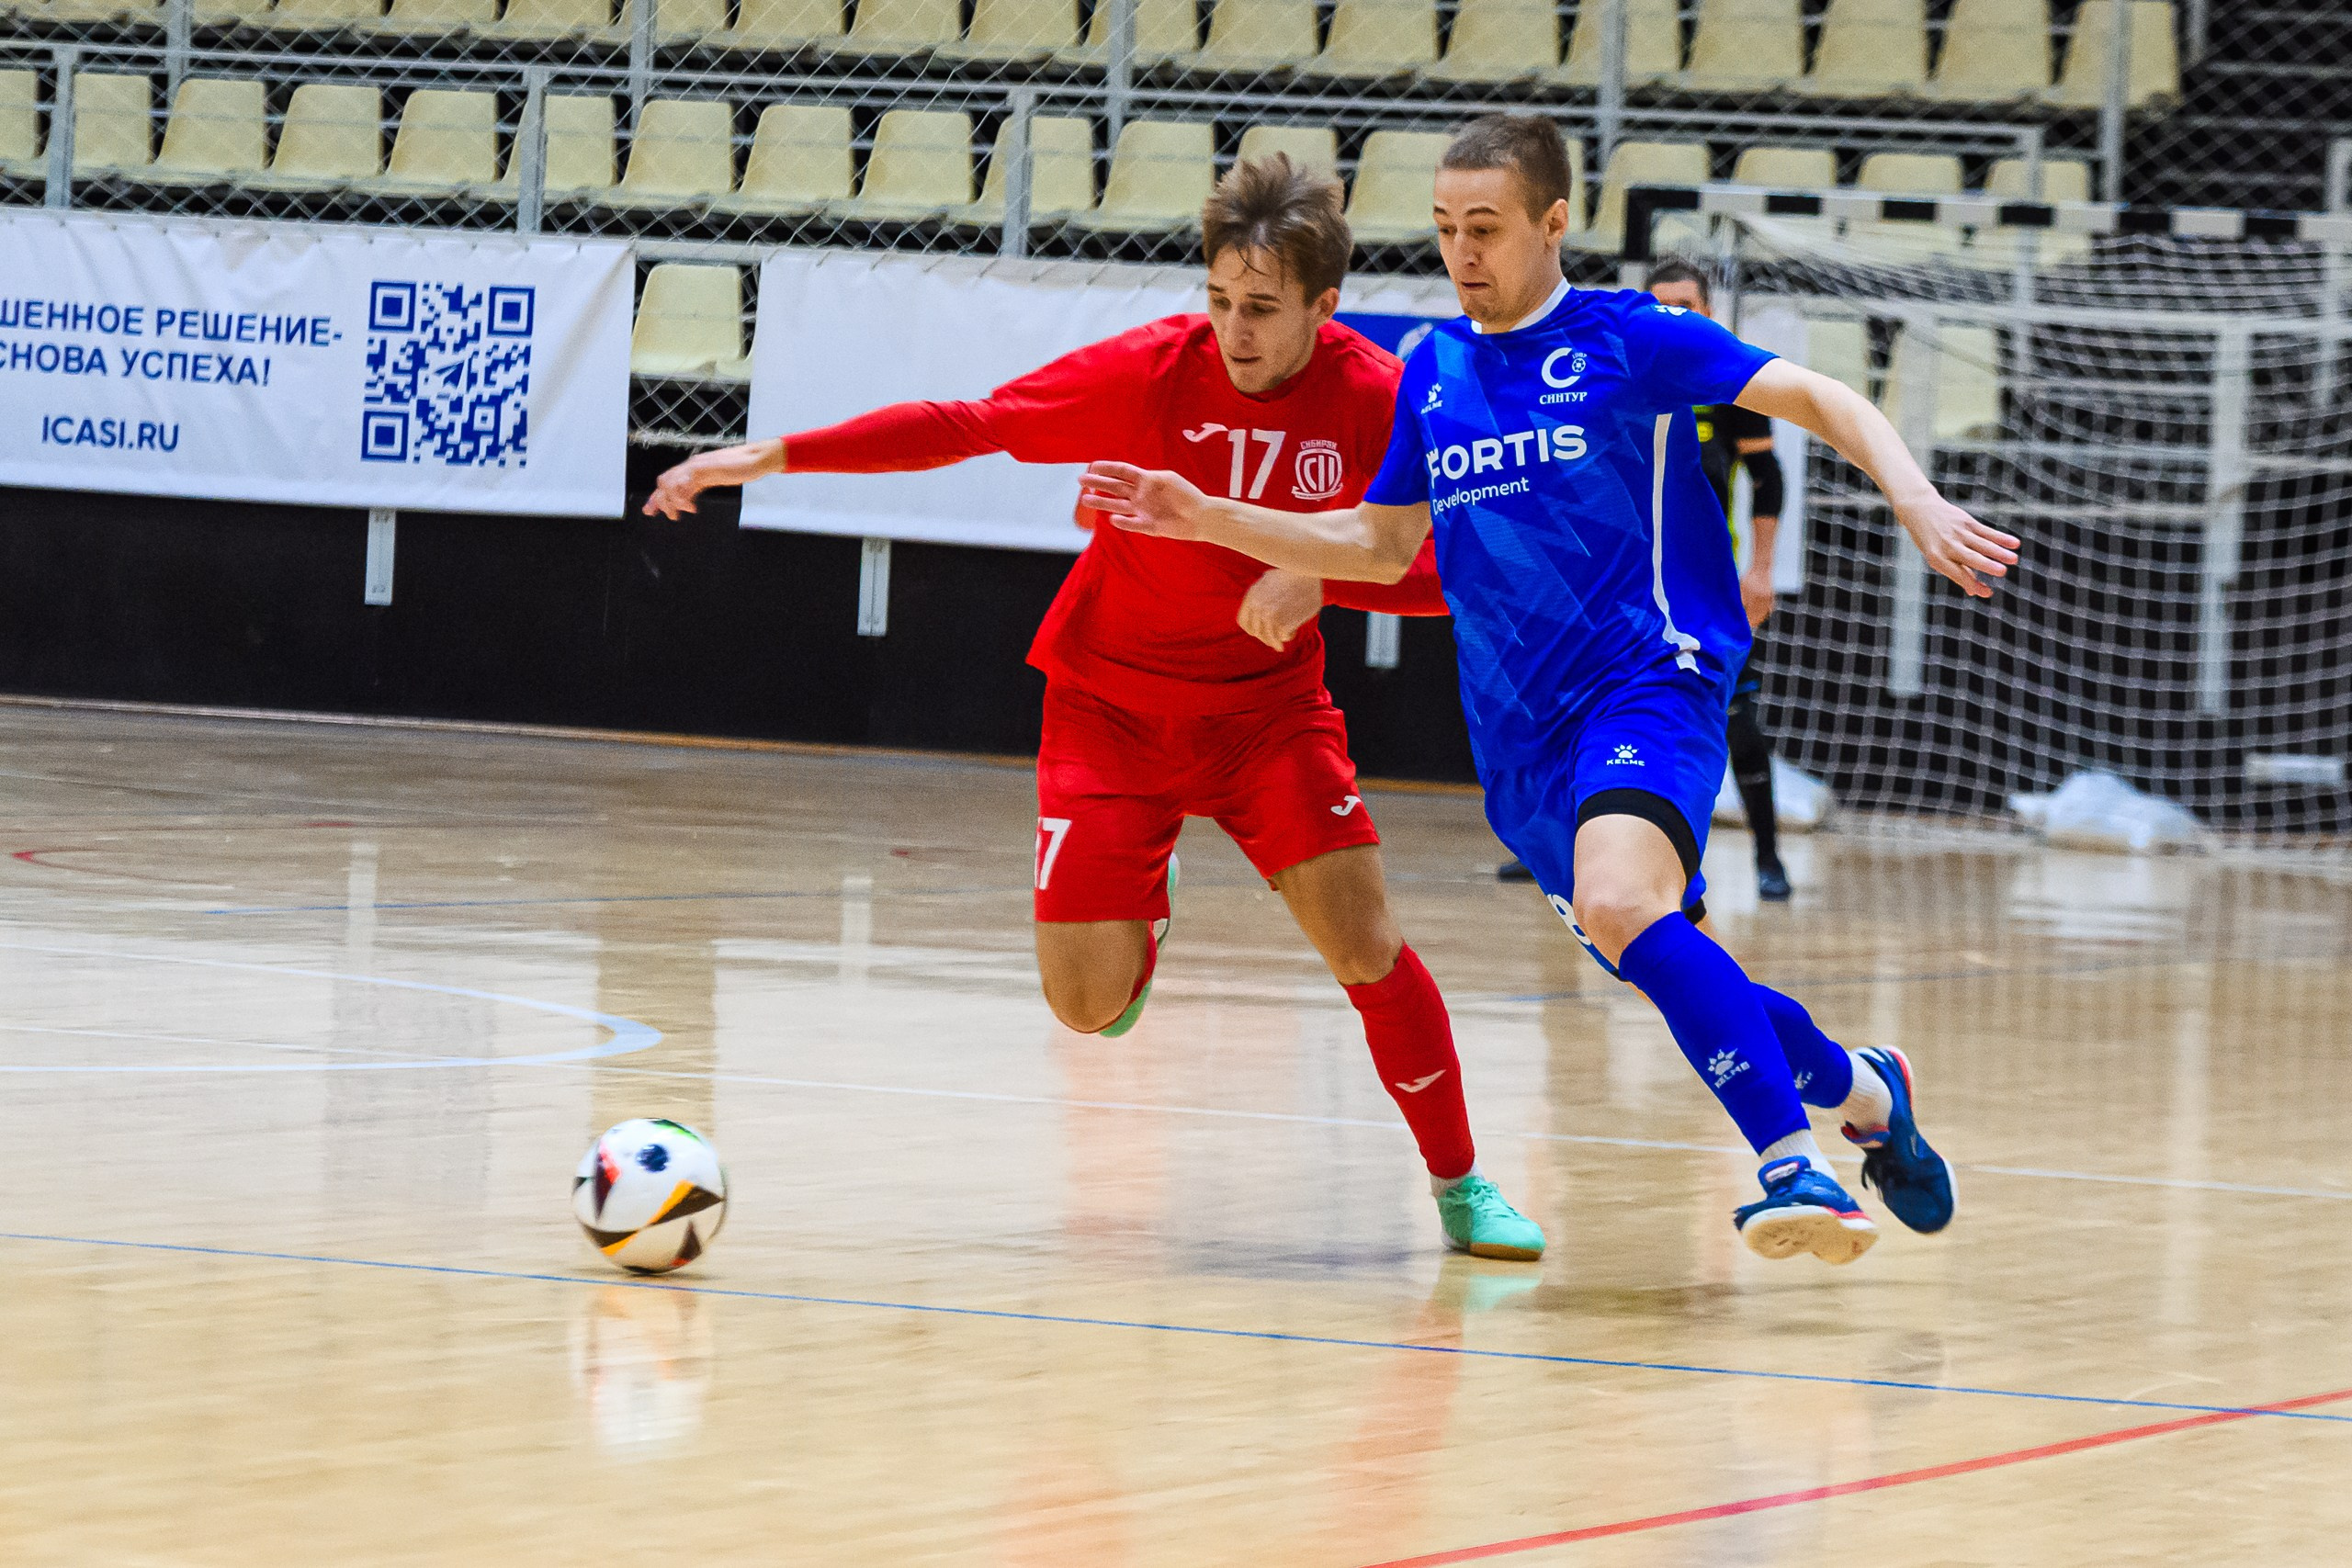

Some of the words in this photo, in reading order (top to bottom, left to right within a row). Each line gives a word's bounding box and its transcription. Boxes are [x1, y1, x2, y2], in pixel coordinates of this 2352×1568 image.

[156, 308, 342, 346] РЕШЕНИЕ-
[120, 347, 271, 386] УСПЕХА!
[1539, 391, 1588, 405] СИНТУР
[42, 415, 179, 452] ICASI.RU
[1227, 428, 1286, 500] 17
[1426, 424, 1588, 490] FORTIS
[1432, 477, 1530, 516] Development
[1606, 759, 1645, 767] KELME
